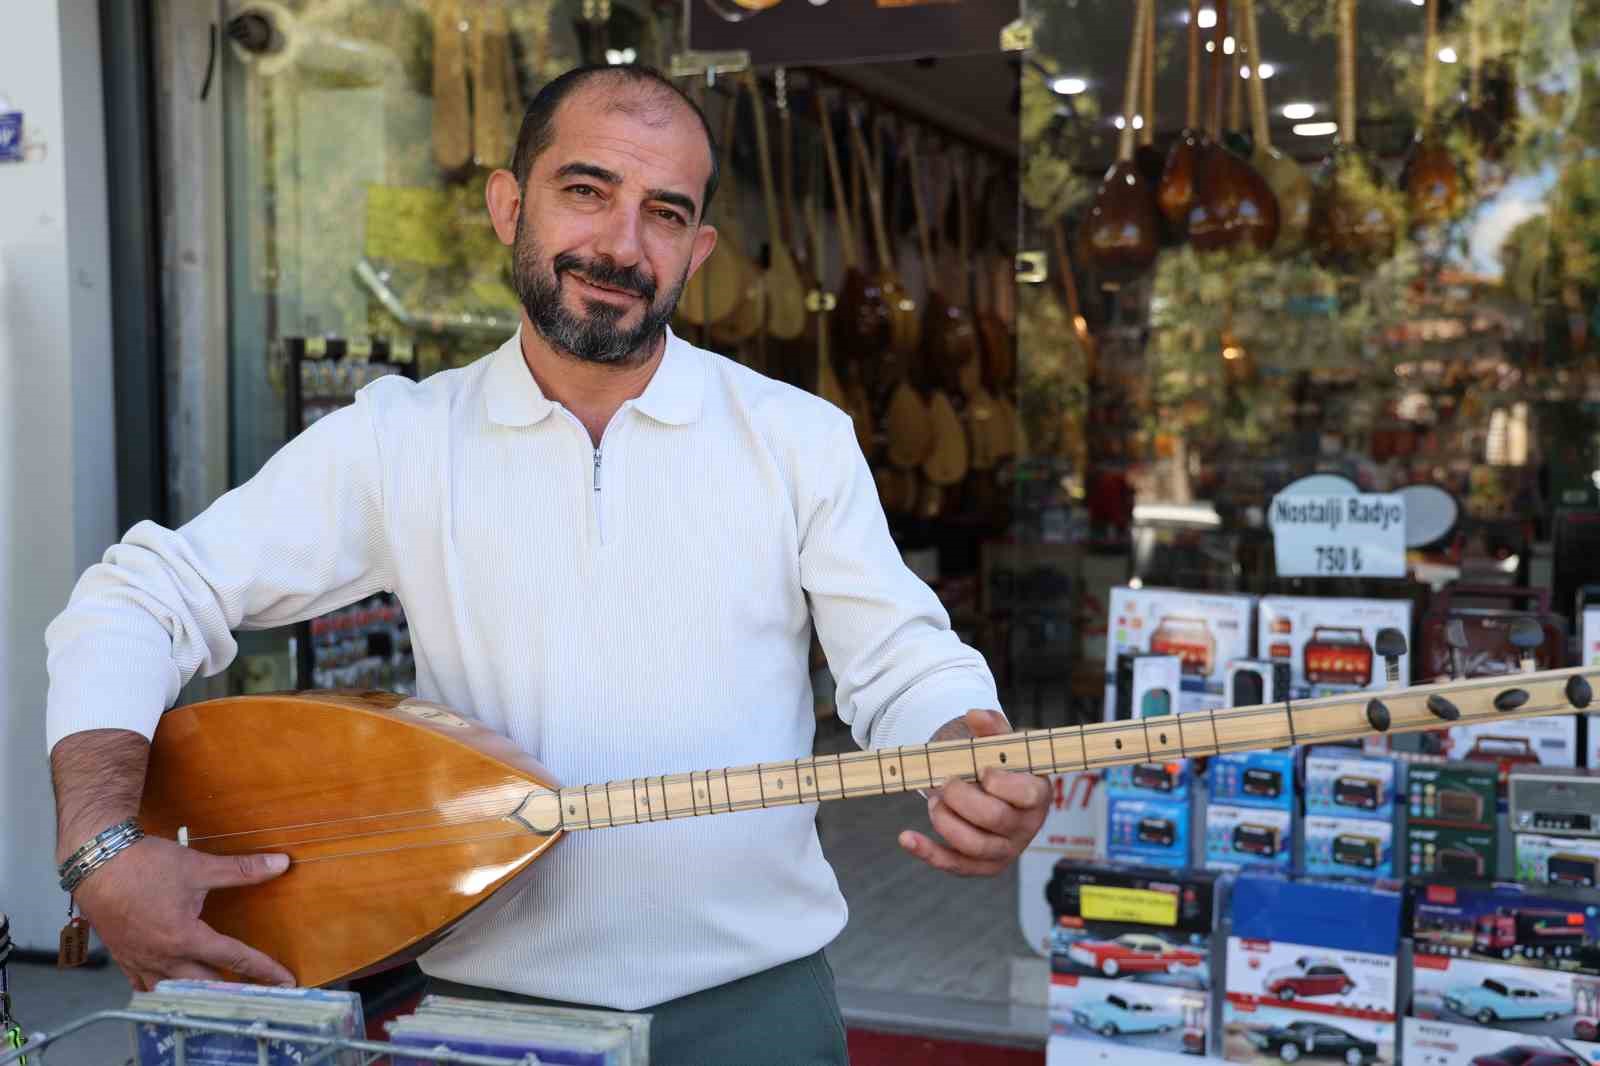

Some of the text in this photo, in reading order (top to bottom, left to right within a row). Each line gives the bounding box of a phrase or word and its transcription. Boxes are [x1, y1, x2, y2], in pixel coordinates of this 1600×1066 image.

[1276, 498, 1401, 530] Nostalji Radyo
[1314, 545, 1346, 572] 750
